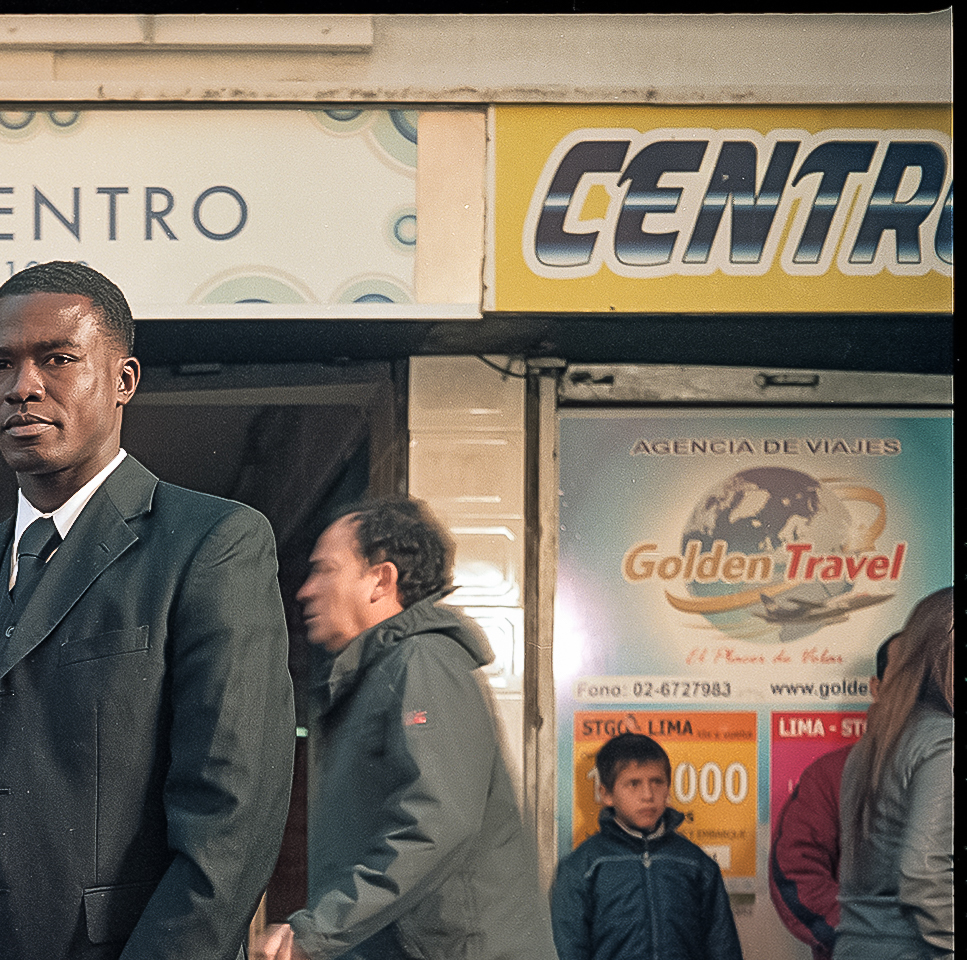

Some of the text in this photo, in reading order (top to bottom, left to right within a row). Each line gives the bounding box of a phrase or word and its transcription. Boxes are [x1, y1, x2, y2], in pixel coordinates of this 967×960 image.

[530, 136, 954, 270] CENTR
[633, 438, 902, 456] AGENCIA DE VIAJES
[623, 540, 907, 583] Golden Travel
[770, 679, 871, 700] www.golde
[648, 719, 694, 736] LIMA
[778, 717, 826, 738] LIMA
